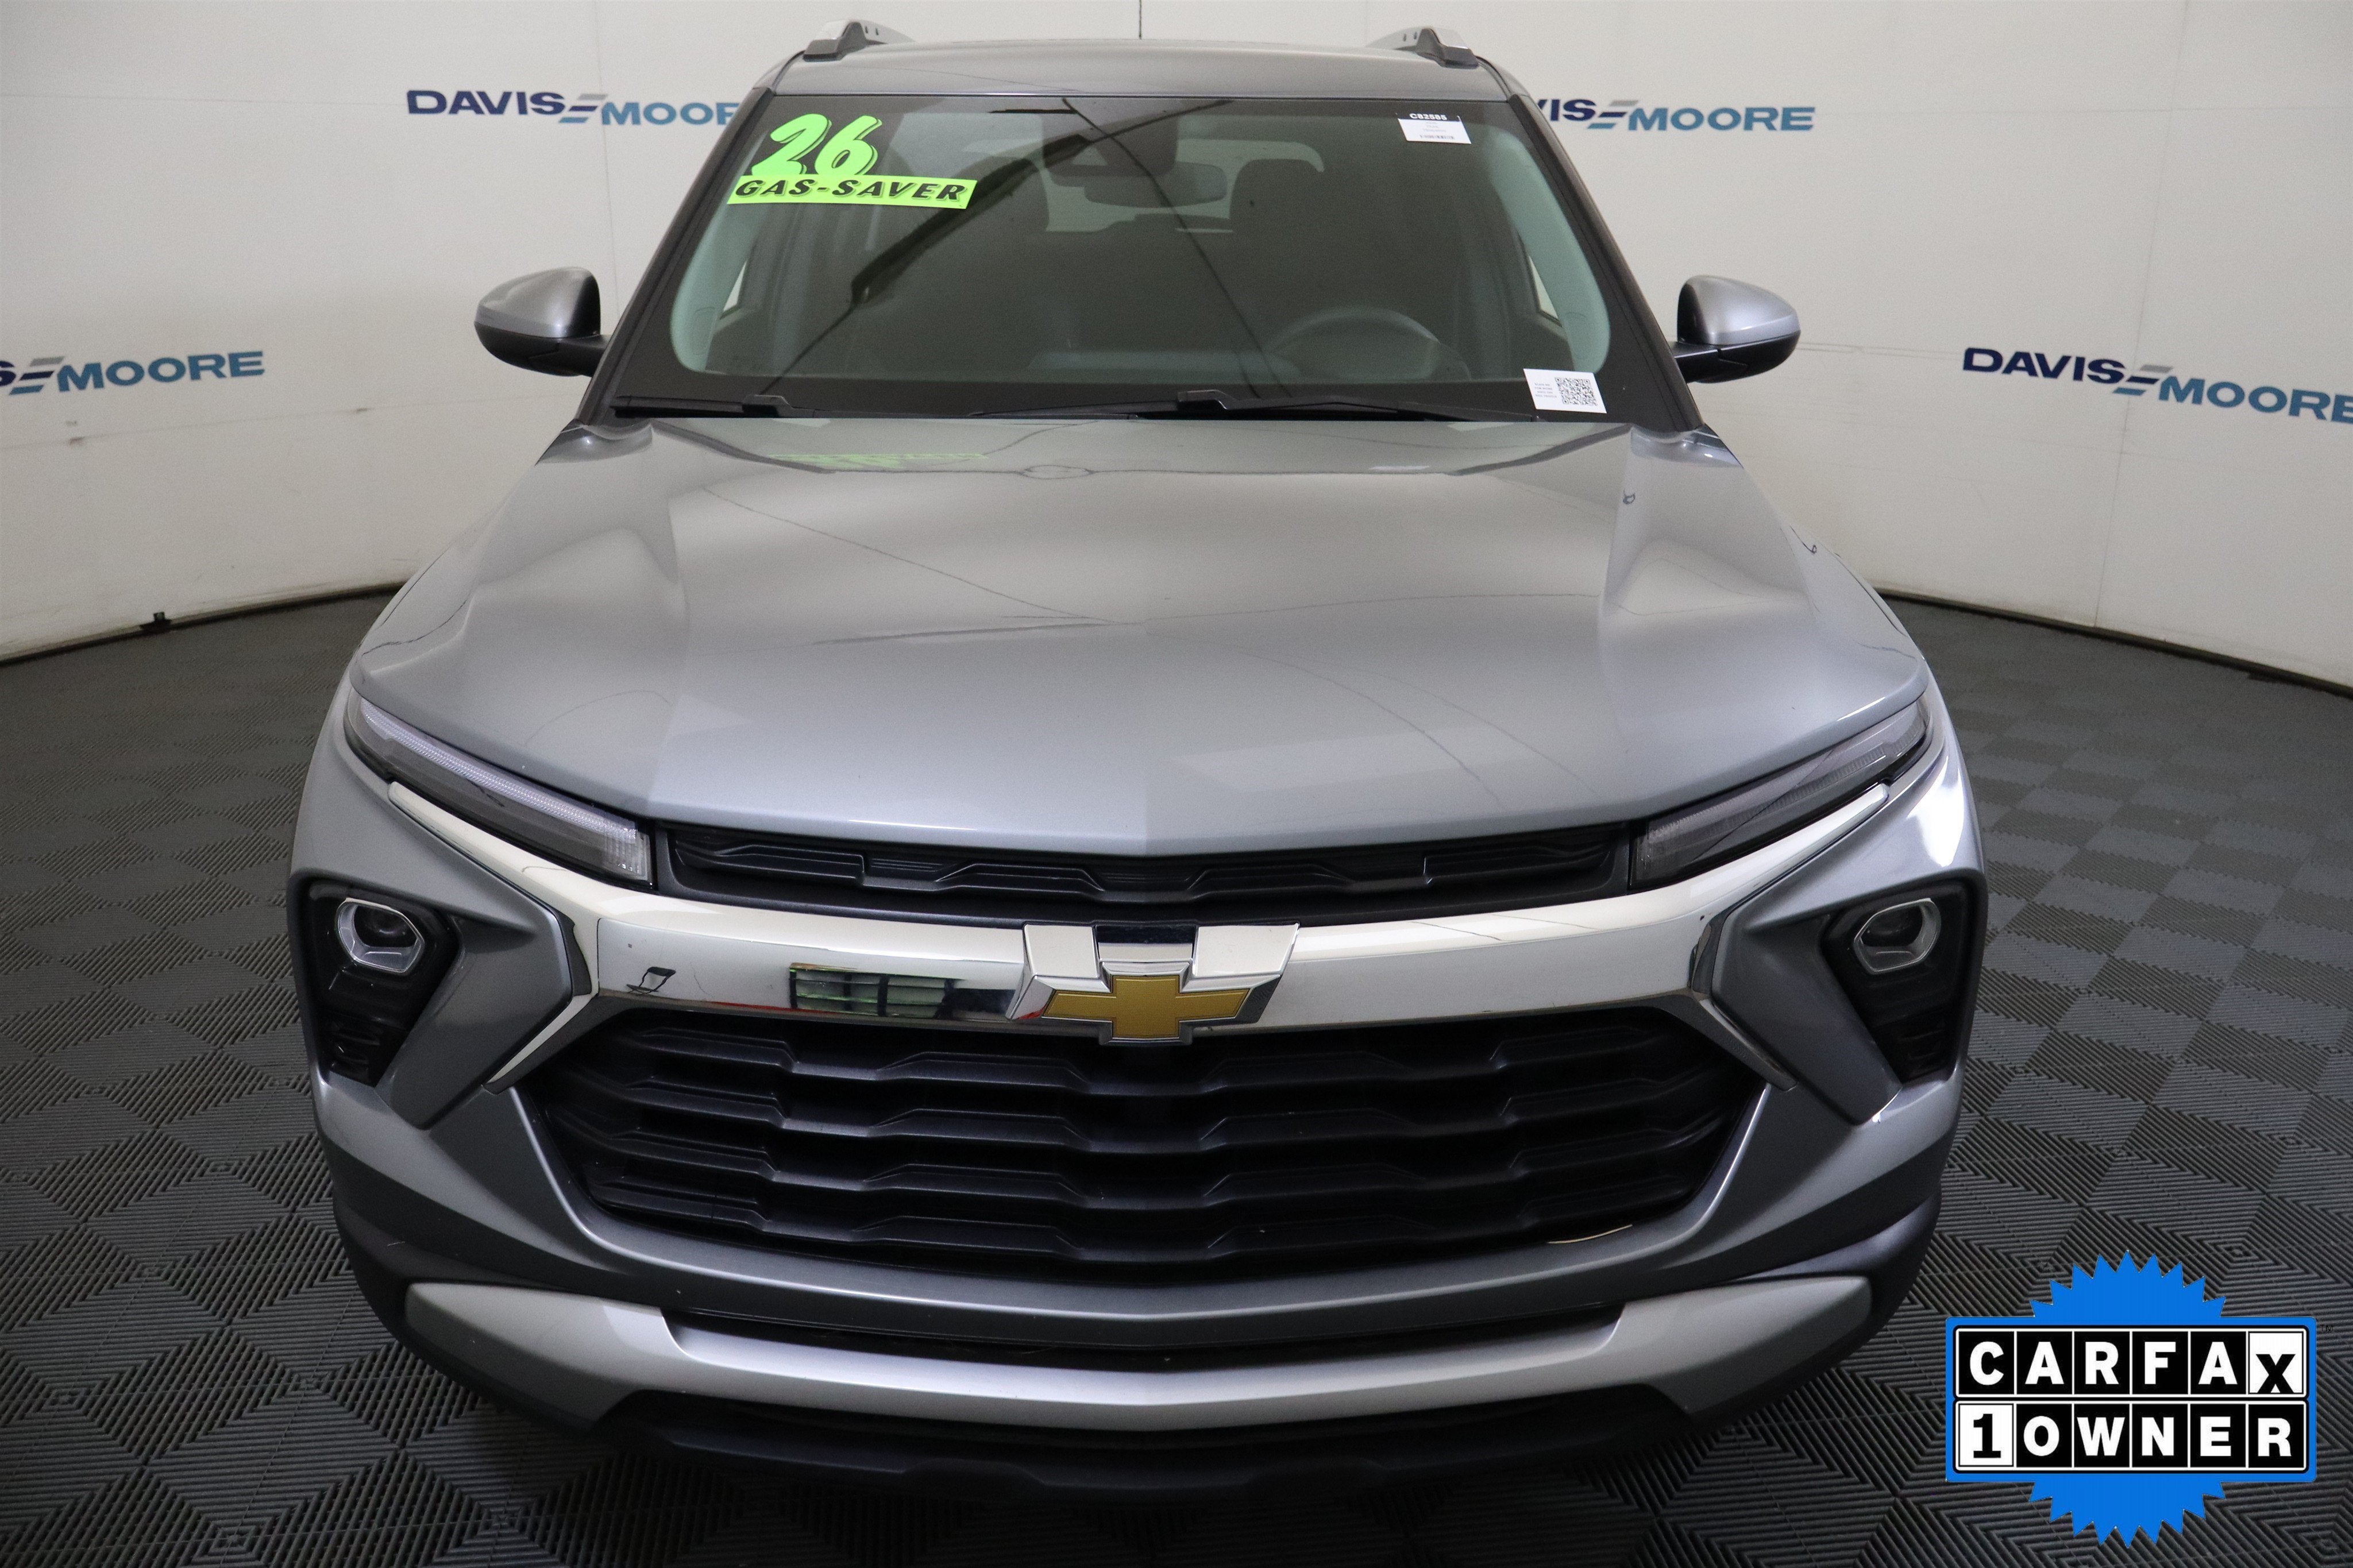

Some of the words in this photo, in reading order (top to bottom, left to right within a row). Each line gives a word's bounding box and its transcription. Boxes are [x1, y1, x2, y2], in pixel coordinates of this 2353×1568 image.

[406, 90, 565, 115] DAVIS
[1628, 107, 1815, 131] MOORE
[751, 113, 882, 176] 26
[735, 179, 966, 201] GAS-SAVER
[56, 350, 266, 393] MOORE
[1962, 347, 2126, 385] DAVIS
